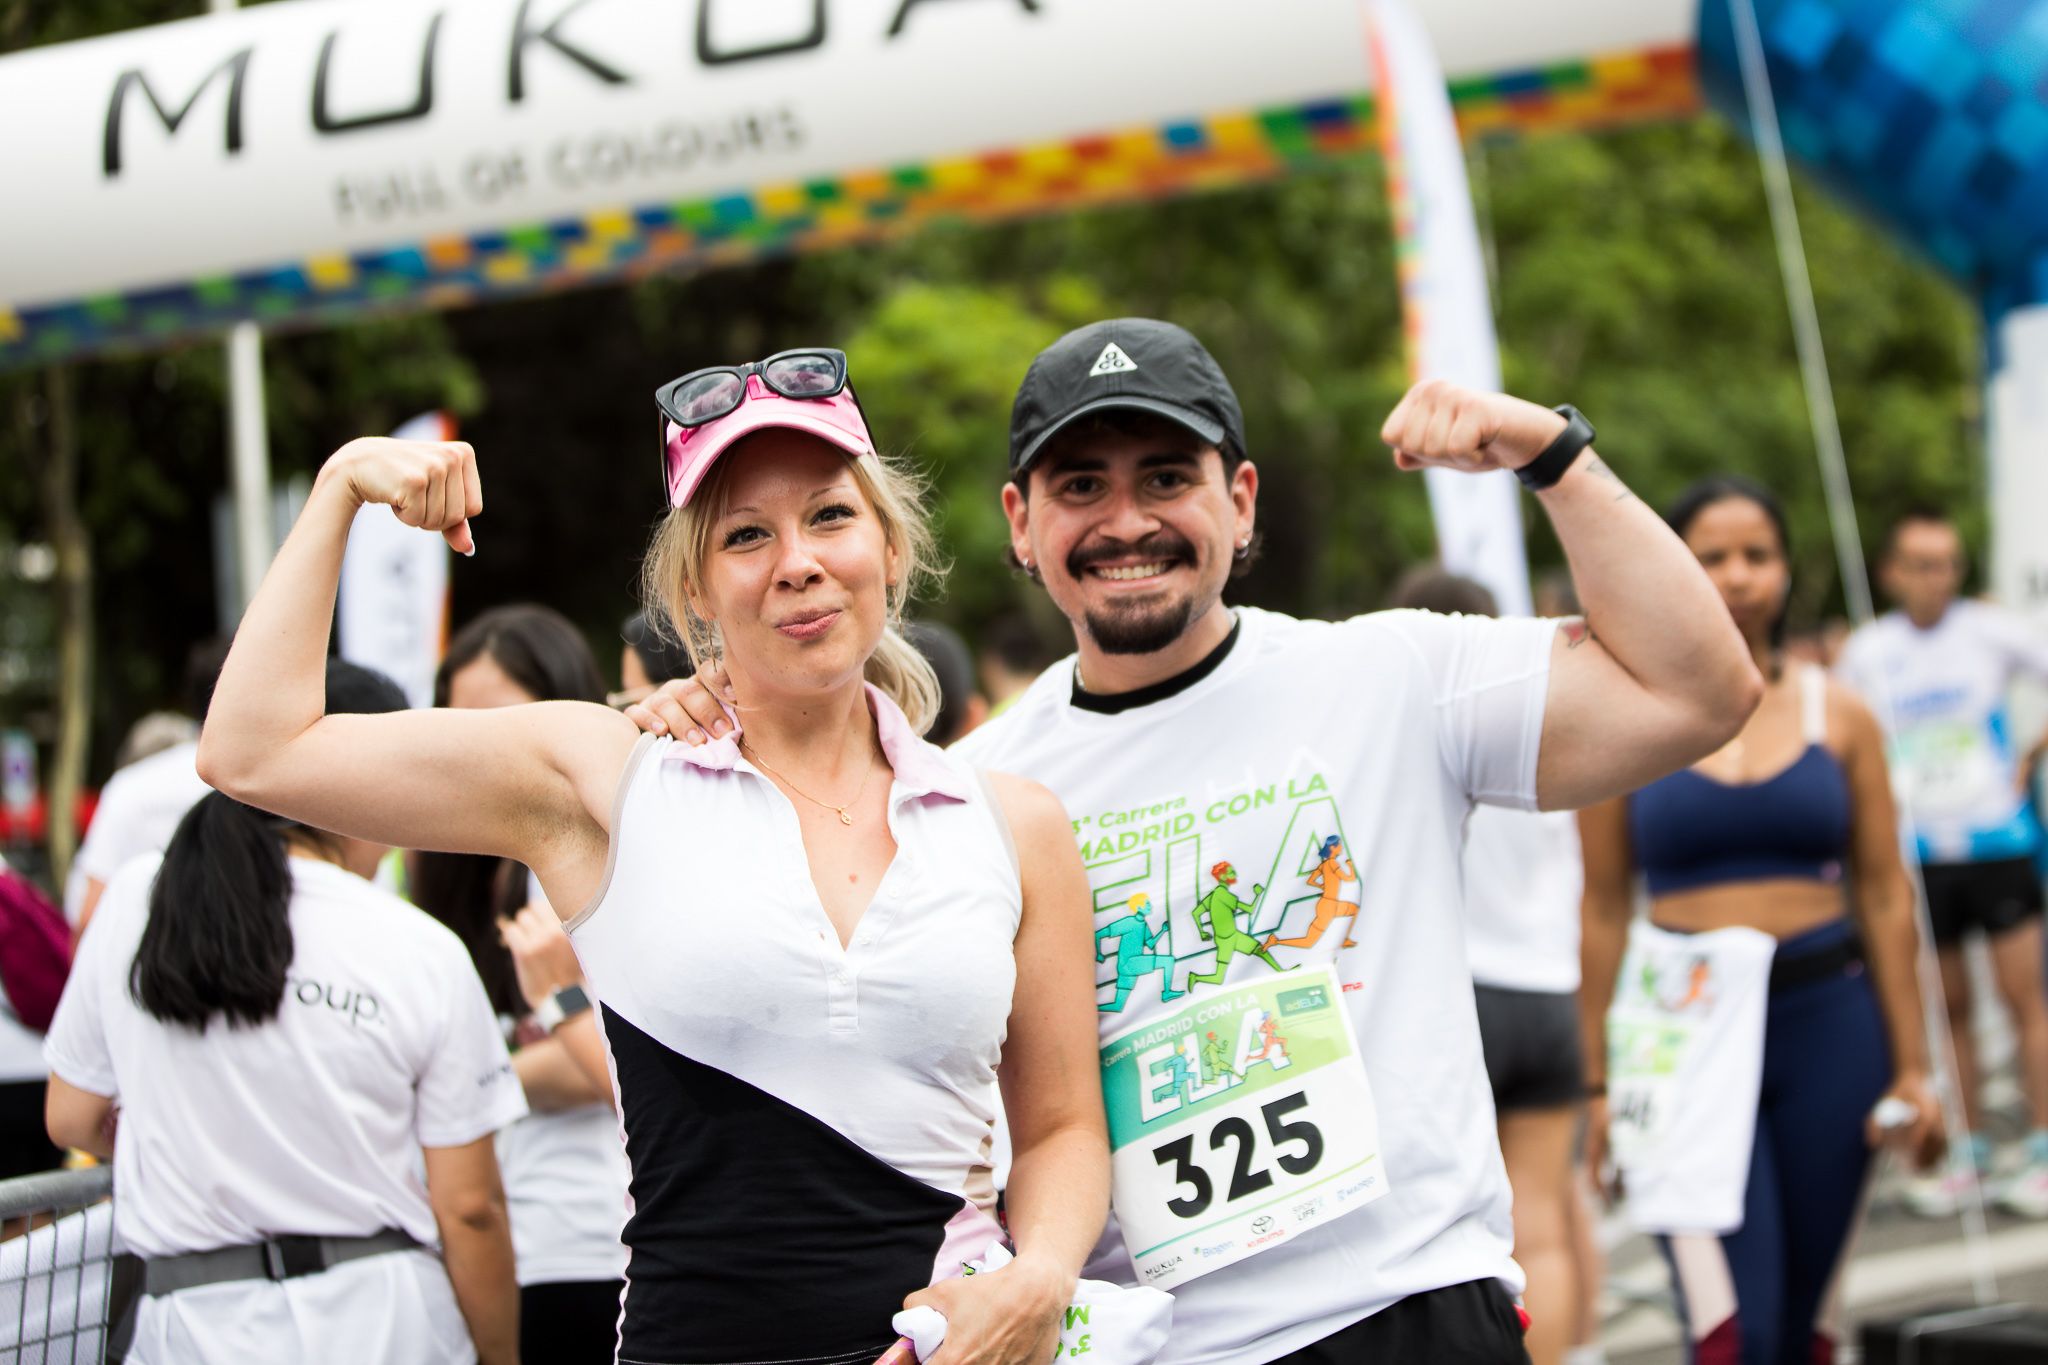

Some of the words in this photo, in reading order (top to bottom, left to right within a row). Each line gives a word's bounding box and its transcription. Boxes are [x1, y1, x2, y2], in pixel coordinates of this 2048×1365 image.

[100, 0, 1042, 178] MUKU
[1098, 797, 1187, 829] Carrera
[1205, 784, 1275, 823] CON
[1287, 772, 1329, 800] LA
[1135, 1018, 1194, 1053] MADRID
[1197, 1002, 1234, 1026] CON
[1236, 991, 1260, 1010] LA
[1136, 1006, 1293, 1124] ELA
[1152, 1090, 1324, 1219] 325
[1145, 1256, 1183, 1277] MUKUA
